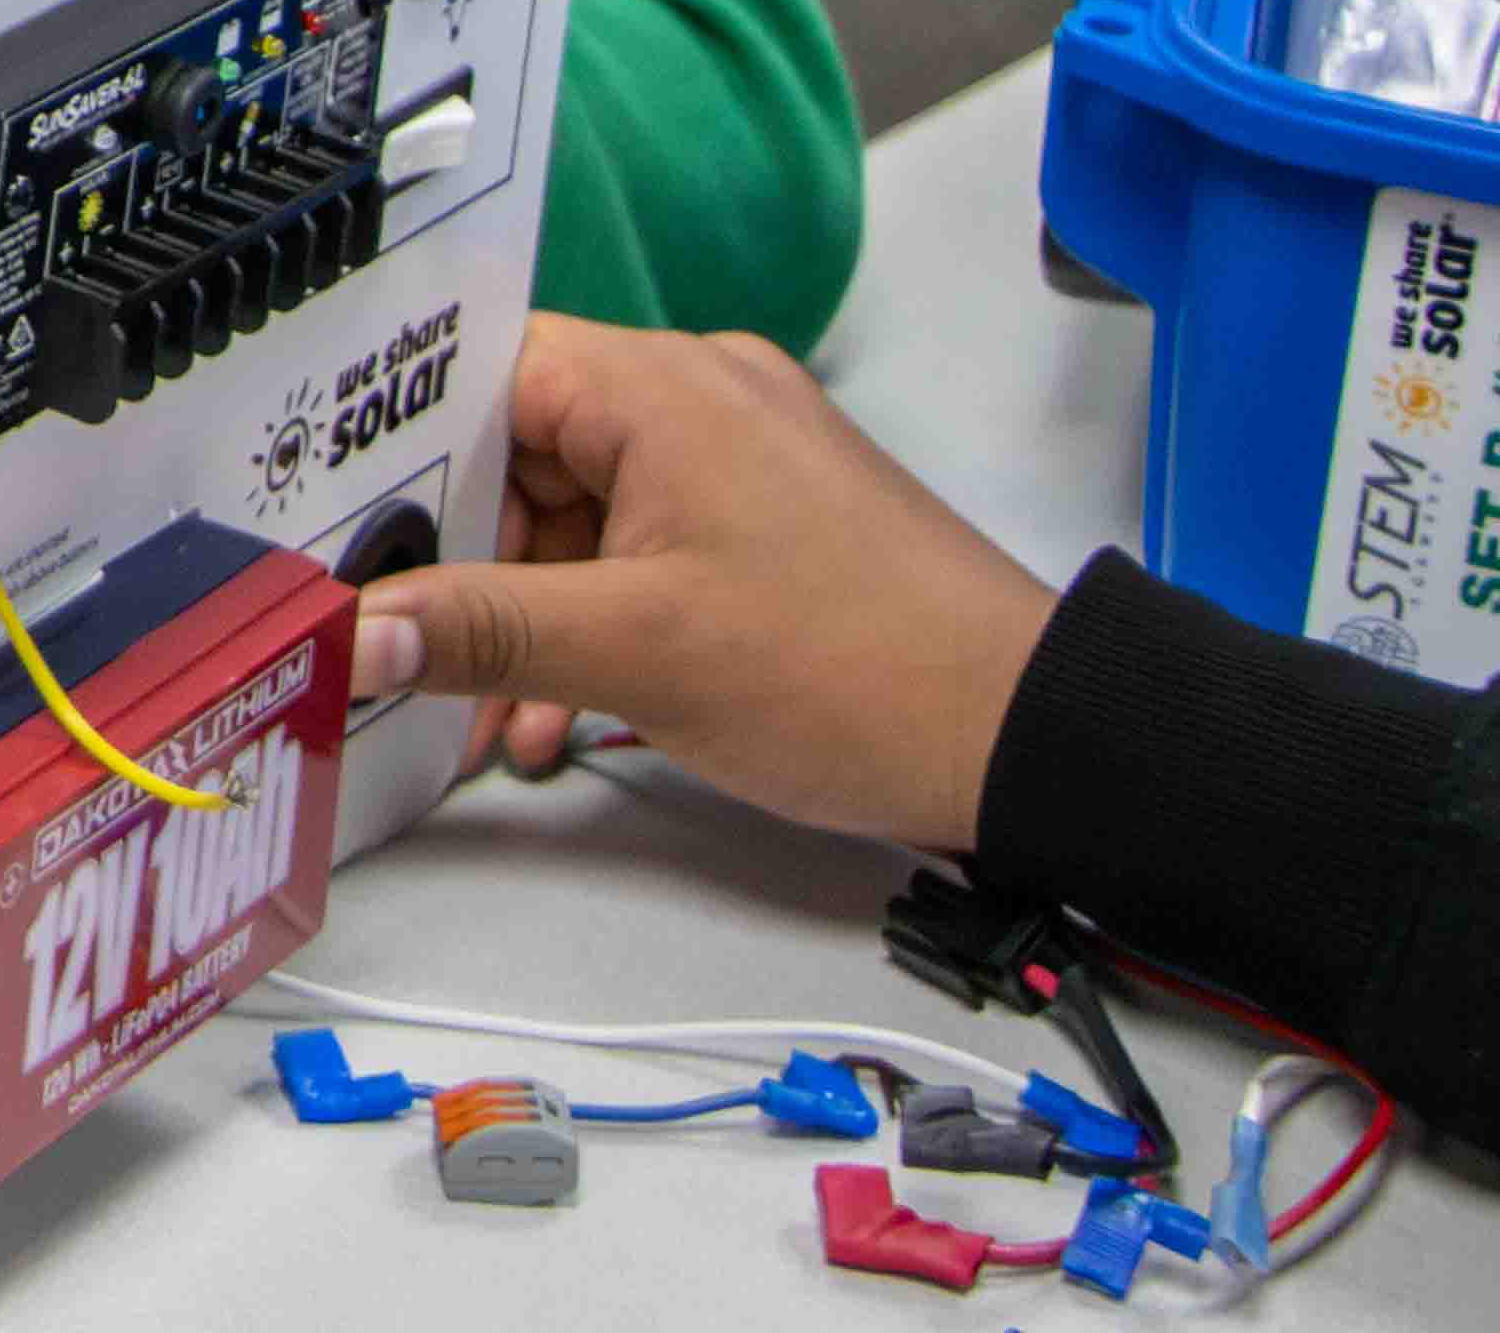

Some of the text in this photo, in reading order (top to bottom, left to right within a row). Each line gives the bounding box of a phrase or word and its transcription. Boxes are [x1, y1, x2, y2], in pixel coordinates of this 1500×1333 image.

[1391, 221, 1433, 349] we share
[1422, 223, 1479, 360] solar
[326, 340, 459, 469] solar
[335, 300, 461, 403] we share
[1348, 438, 1427, 620] STEM
[192, 656, 310, 754] LITHIUM
[20, 815, 150, 1078] 12V
